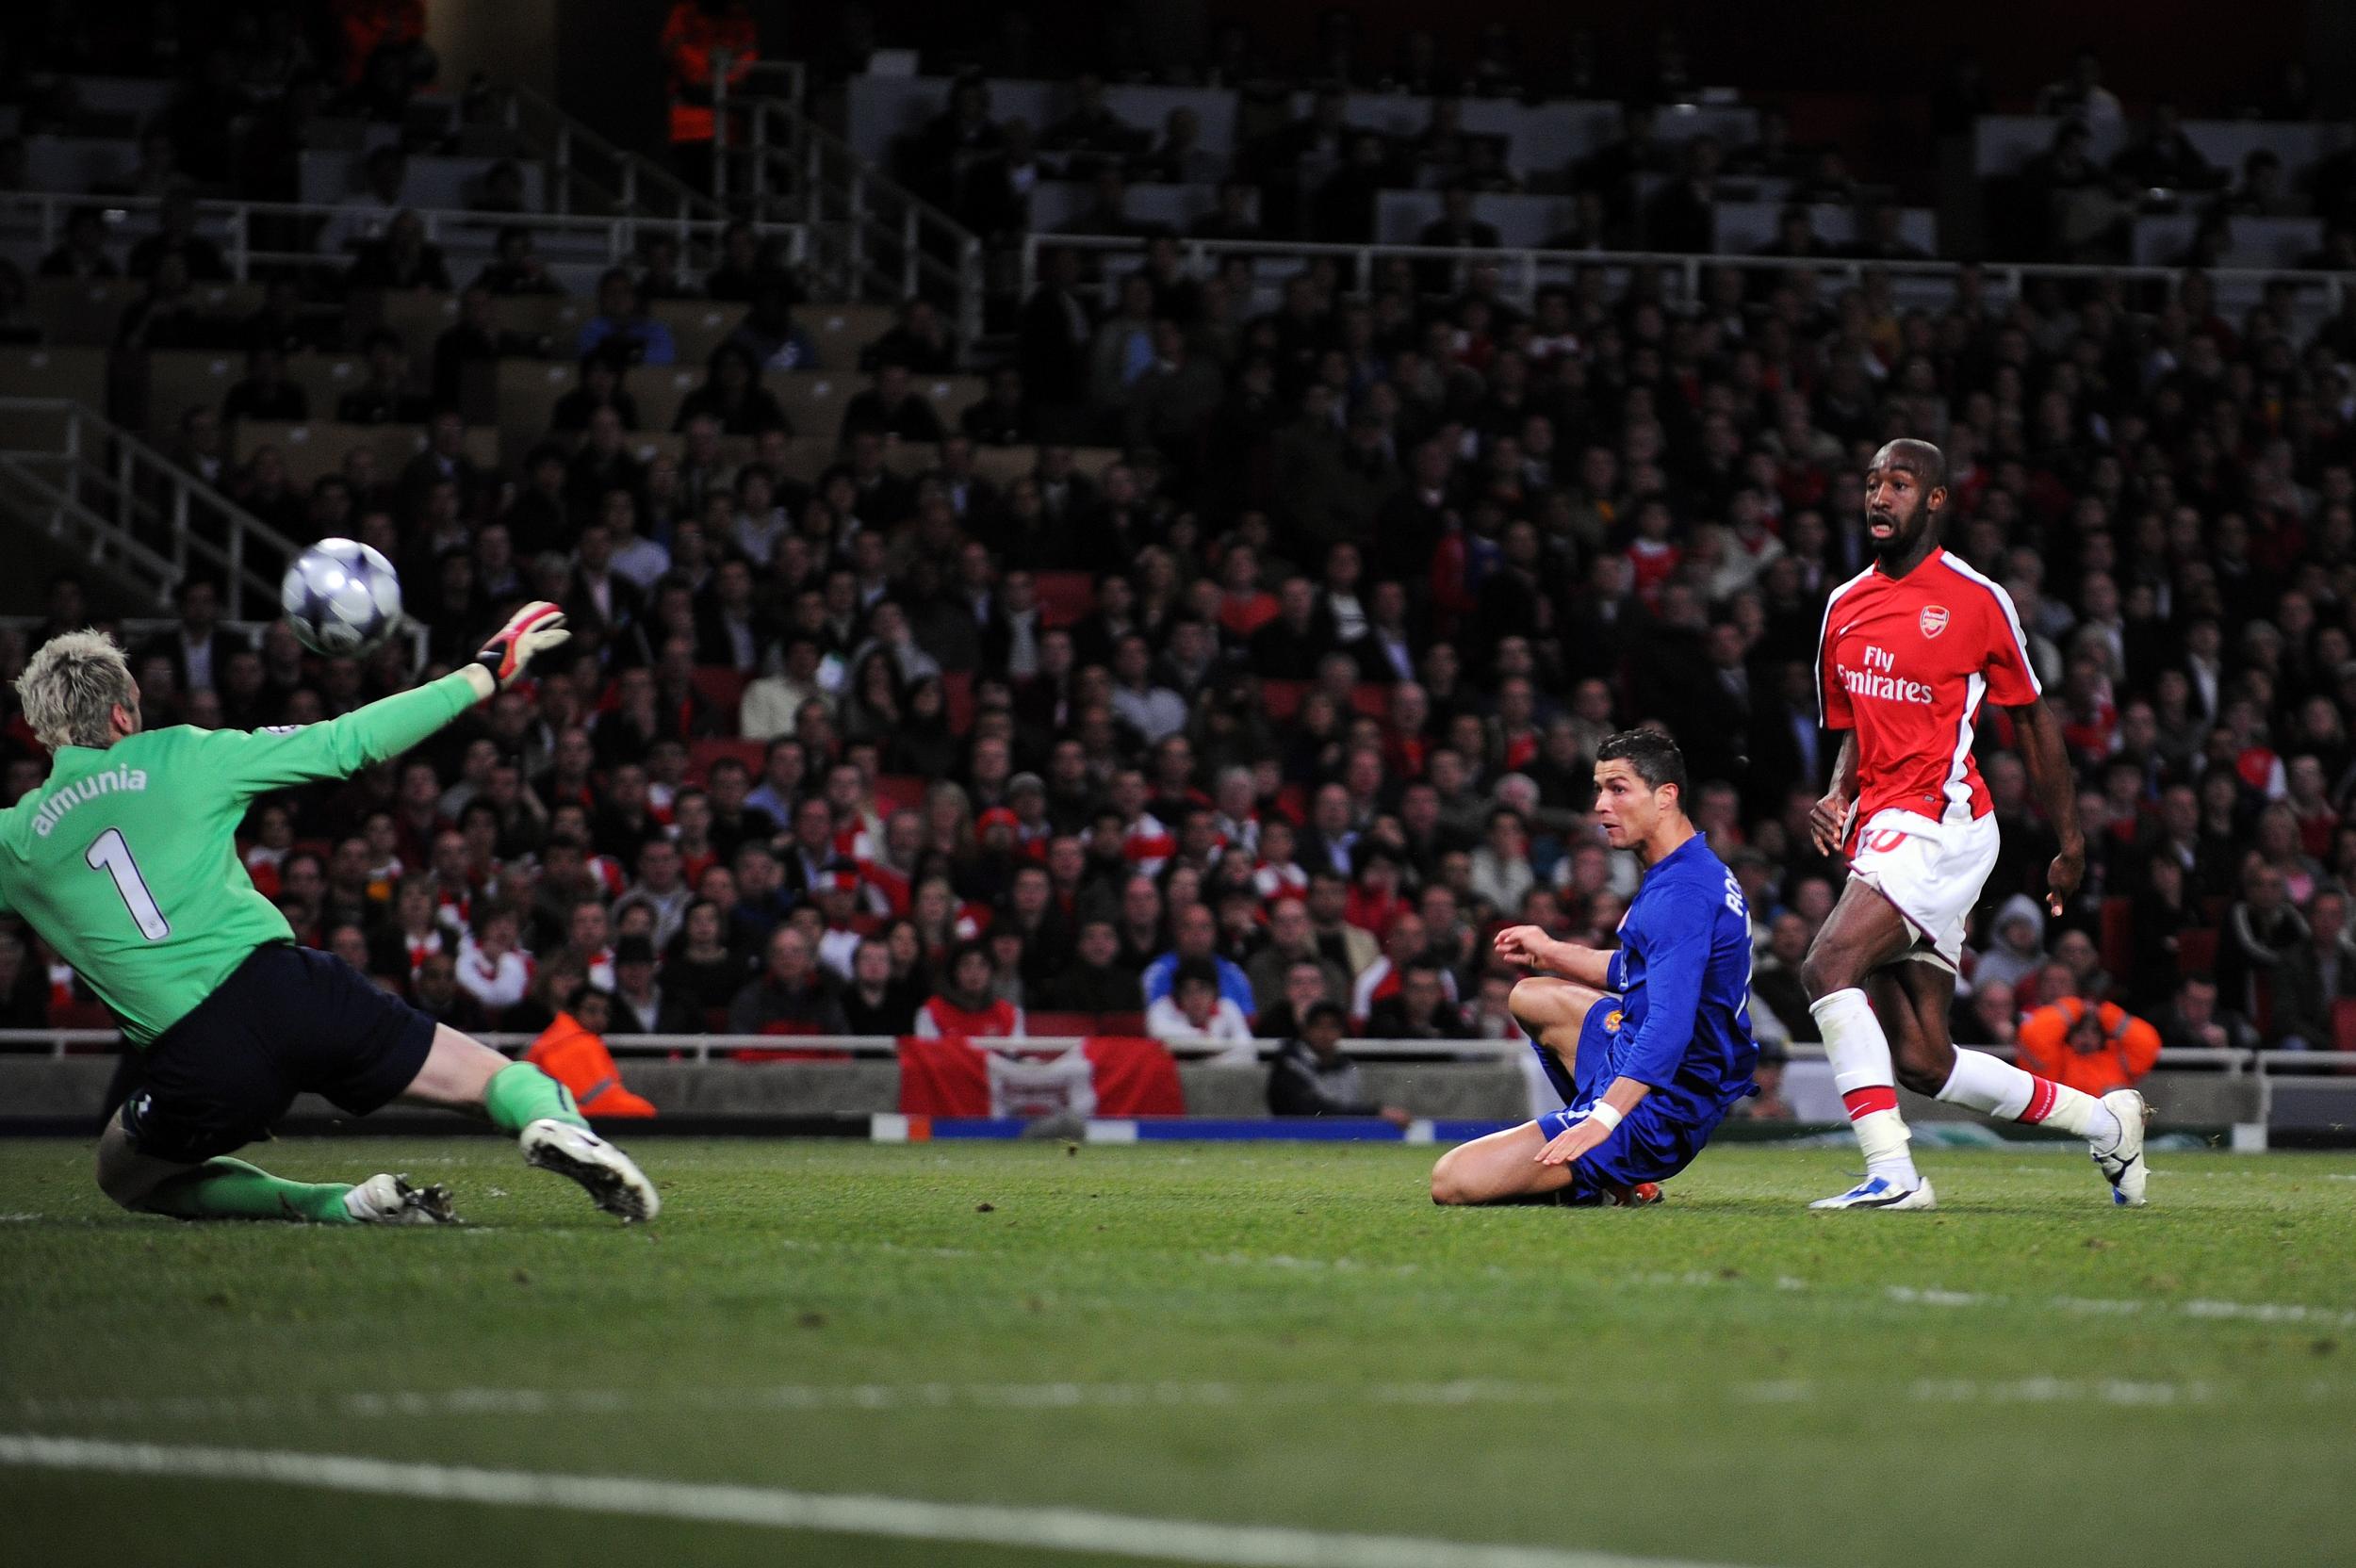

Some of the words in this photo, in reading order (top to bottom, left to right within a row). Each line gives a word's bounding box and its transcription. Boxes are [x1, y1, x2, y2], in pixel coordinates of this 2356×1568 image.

[1864, 645, 1894, 673] Fly
[31, 762, 147, 838] almunia
[85, 826, 171, 941] 1
